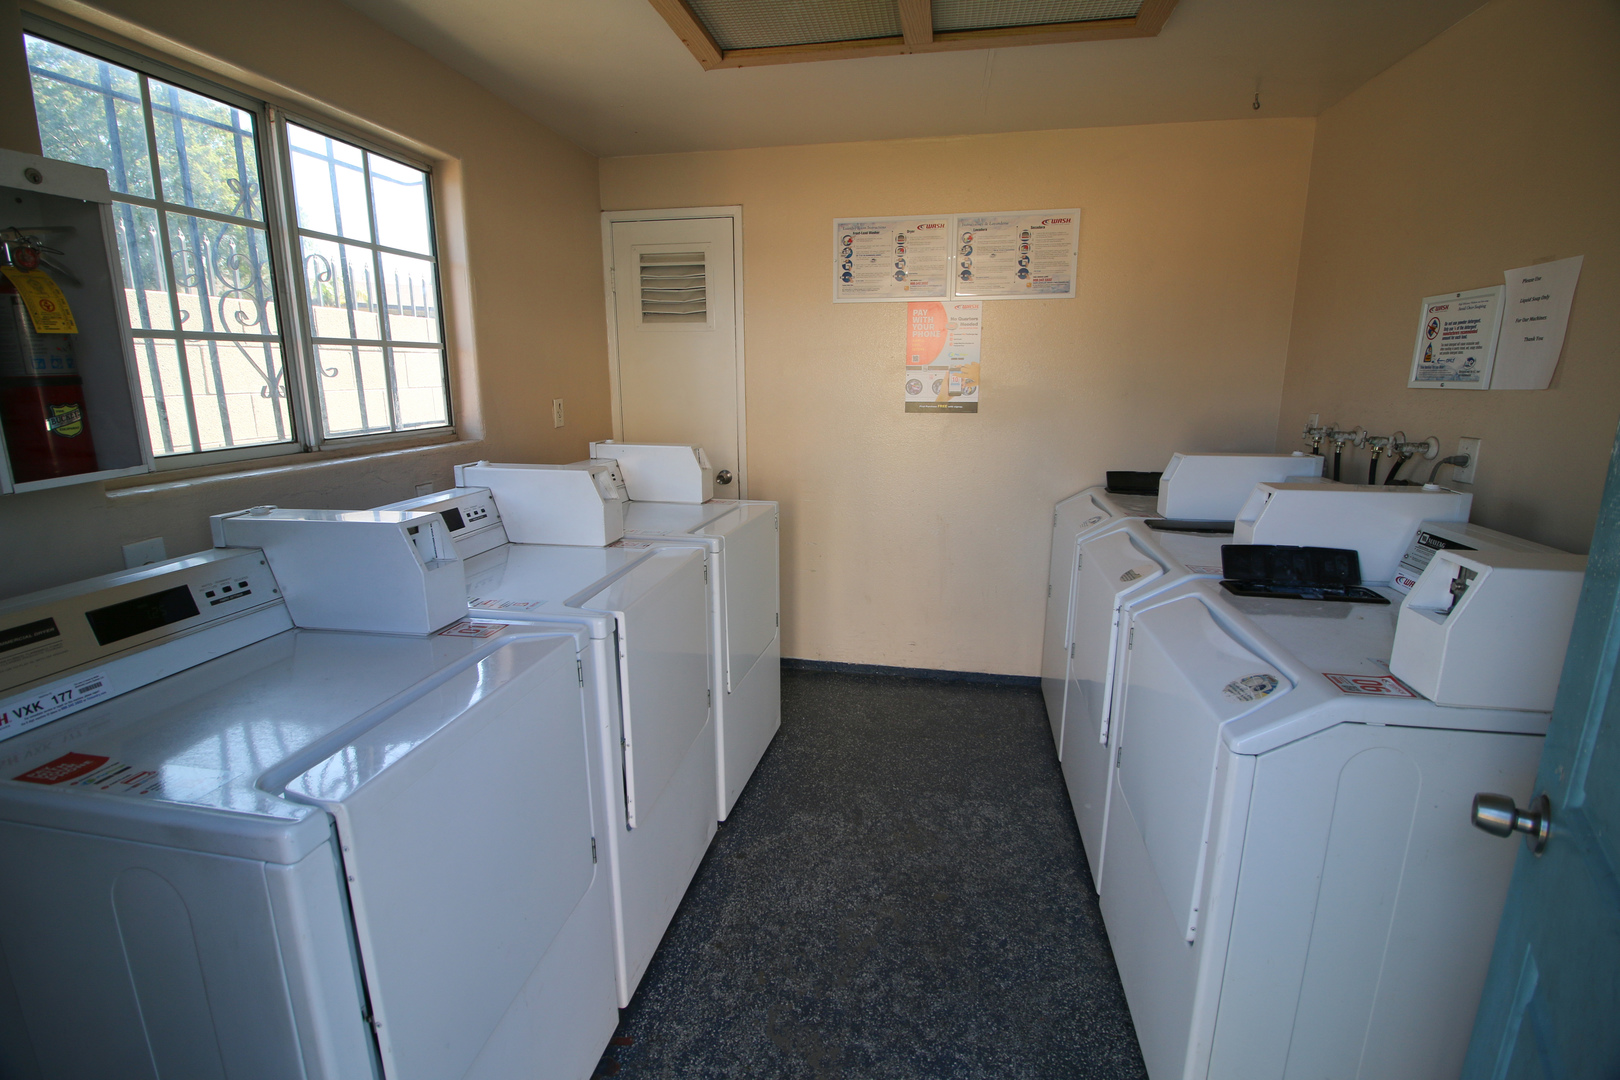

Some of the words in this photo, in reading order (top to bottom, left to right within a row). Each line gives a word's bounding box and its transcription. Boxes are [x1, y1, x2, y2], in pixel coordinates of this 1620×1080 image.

[1404, 579, 1416, 588] WA
[0, 634, 32, 646] MMERCIAL
[34, 627, 55, 637] DRYER
[12, 700, 44, 718] VXK
[51, 690, 73, 704] 177
